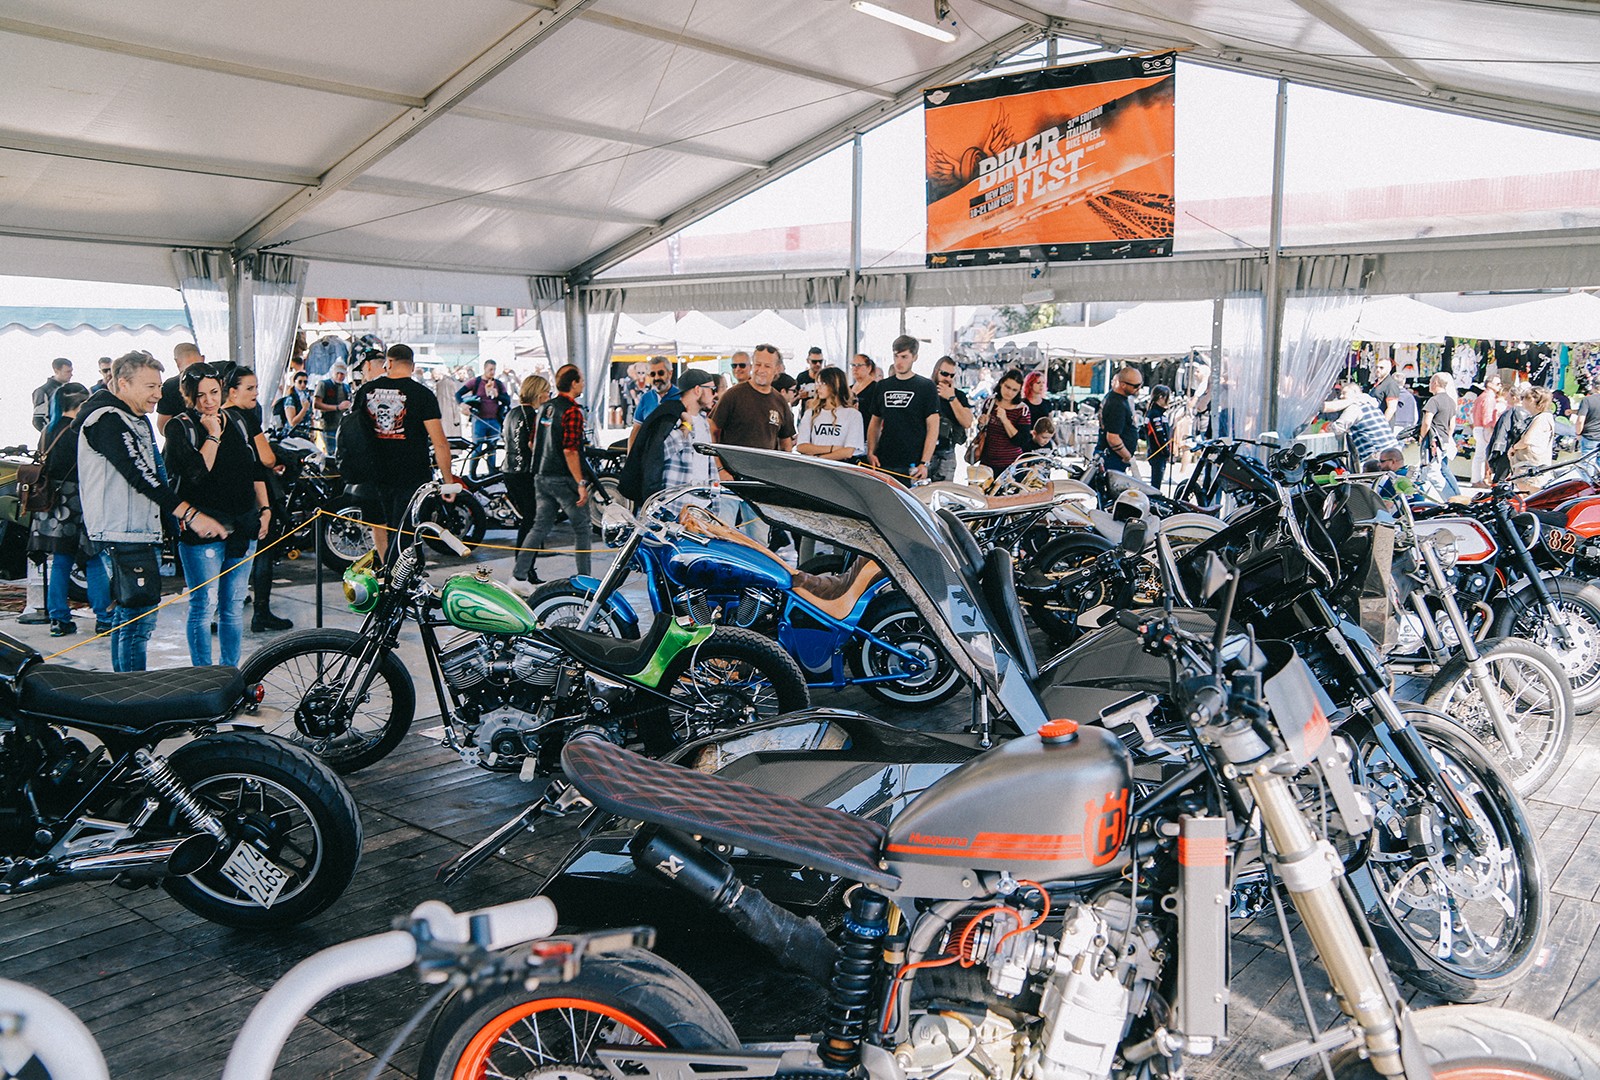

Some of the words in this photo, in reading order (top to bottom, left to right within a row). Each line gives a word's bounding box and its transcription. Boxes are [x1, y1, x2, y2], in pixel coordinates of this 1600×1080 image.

[1080, 105, 1103, 123] EDITION
[1065, 121, 1092, 140] ITALIAN
[1065, 136, 1081, 151] BIKE
[1081, 127, 1102, 145] WEEK
[978, 126, 1063, 192] BIKER
[1016, 148, 1085, 206] FEST
[984, 188, 999, 202] NEW
[987, 199, 1000, 213] MAY
[888, 392, 909, 400] VANS
[814, 423, 842, 437] VANS
[1549, 529, 1577, 555] 82
[908, 832, 969, 848] Husqvarna
[1097, 808, 1122, 853] H
[249, 861, 284, 904] 2465
